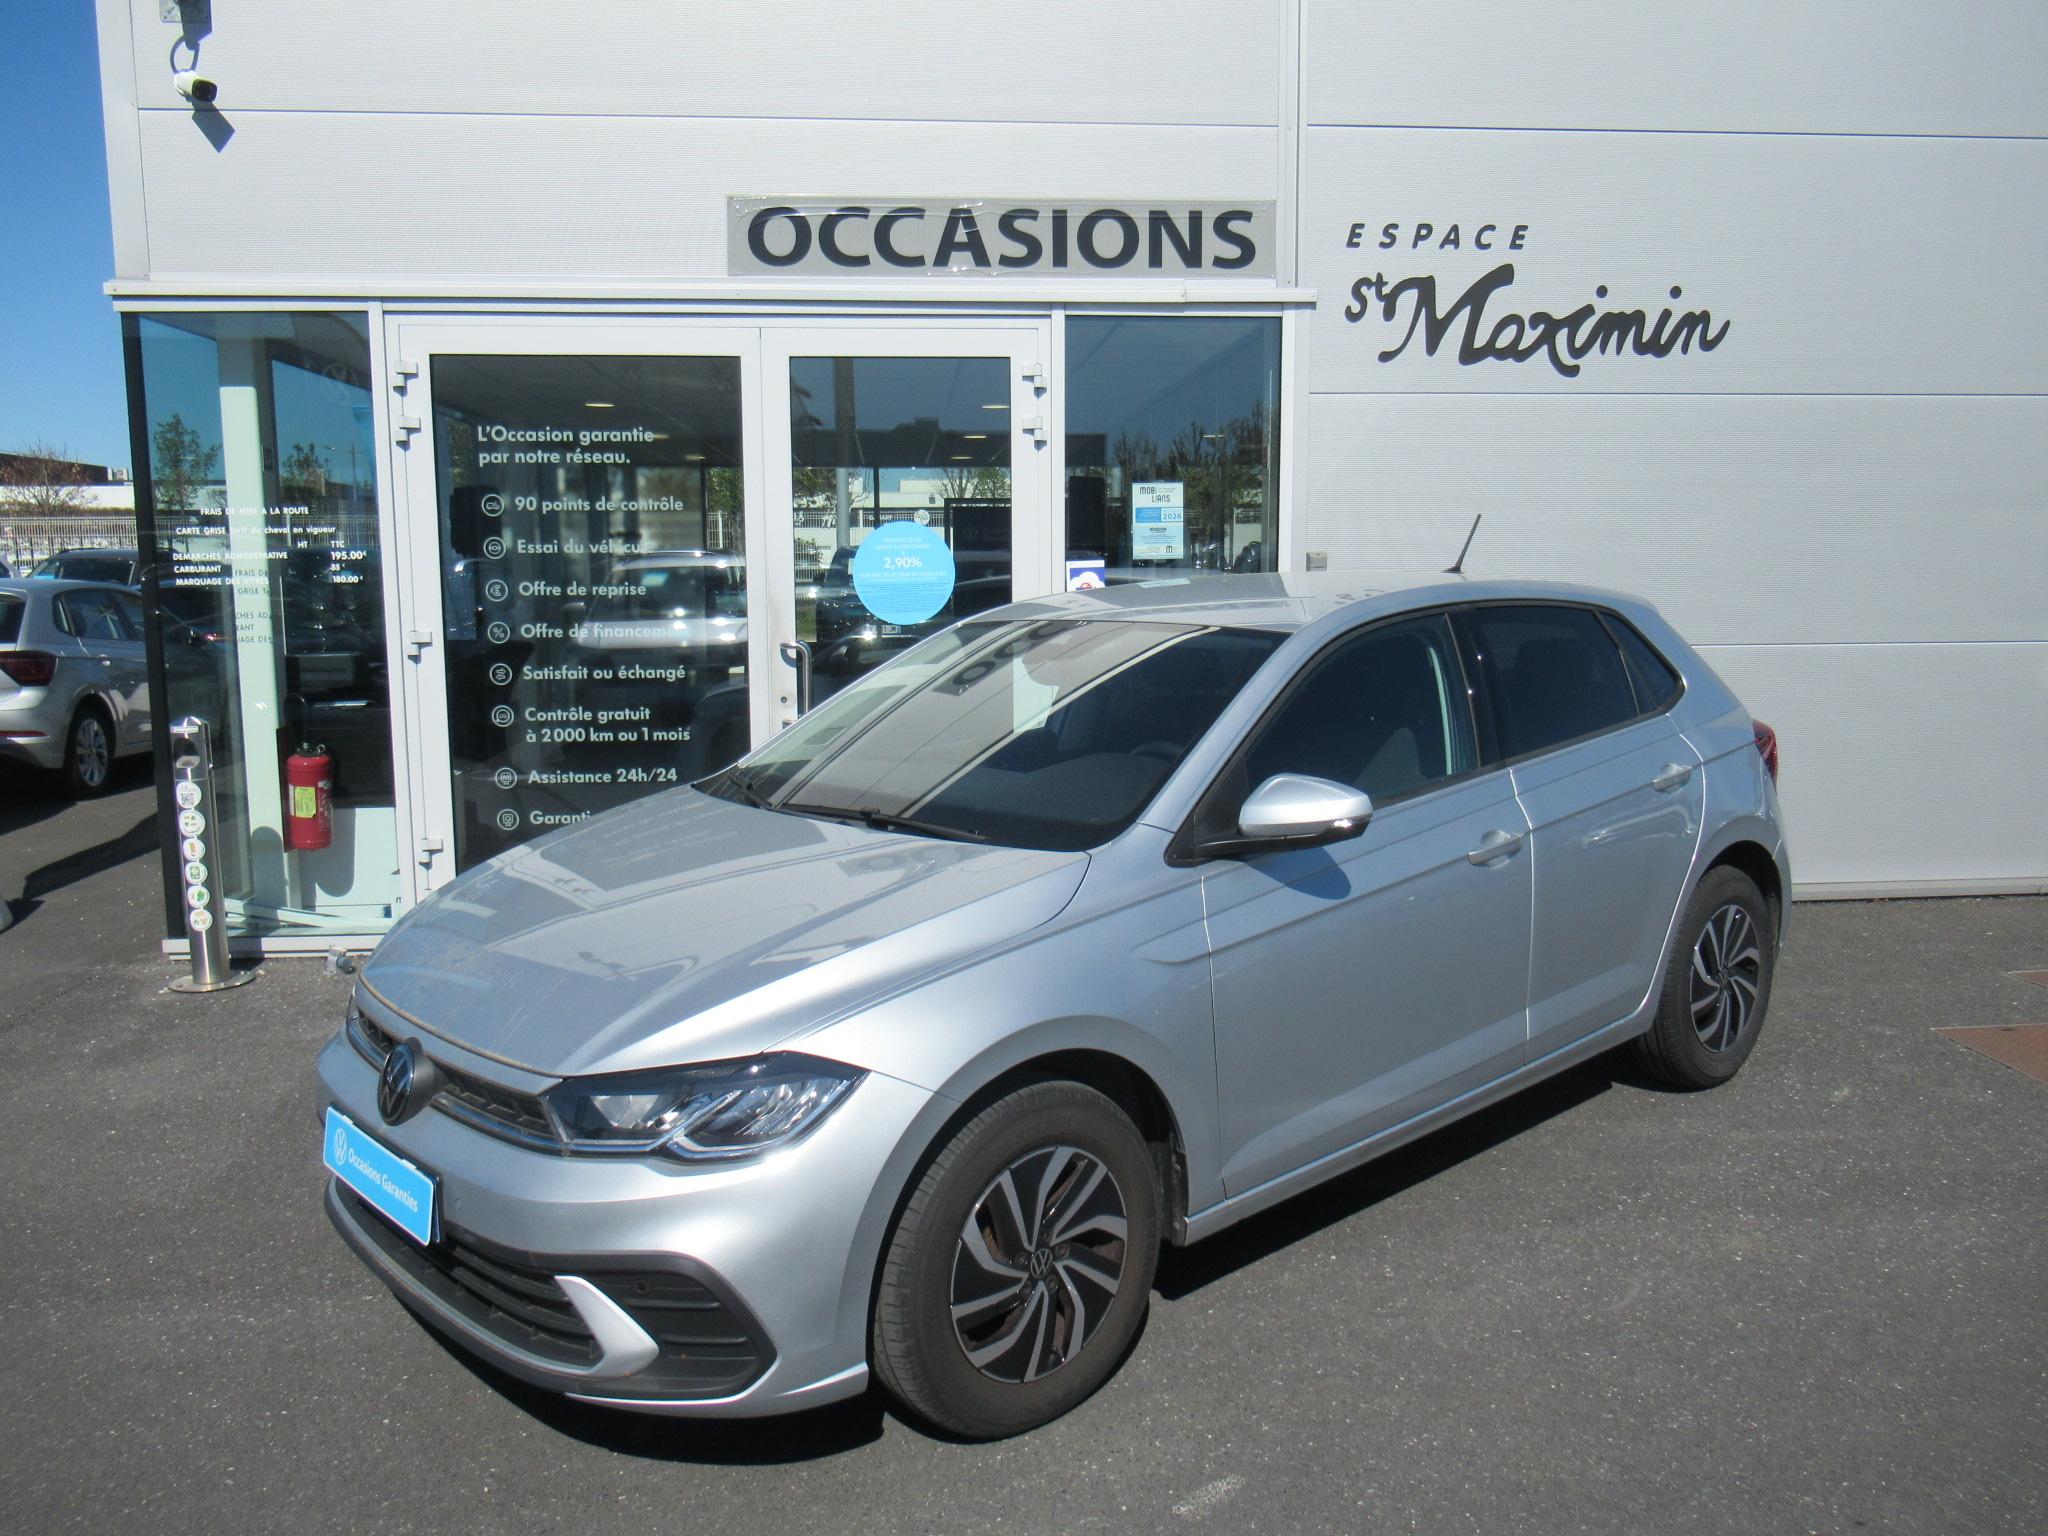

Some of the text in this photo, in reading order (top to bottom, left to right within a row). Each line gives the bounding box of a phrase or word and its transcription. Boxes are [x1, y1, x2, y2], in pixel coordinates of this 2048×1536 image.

[747, 207, 1257, 269] OCCASIONS
[1346, 223, 1529, 250] ESPACE
[1377, 263, 1731, 378] Maximin
[478, 426, 654, 445] L'Occasion garantie
[479, 448, 630, 467] par notre réseau.
[270, 507, 281, 515] LA
[283, 506, 309, 515] ROUTE
[515, 495, 683, 514] 90 points de contrôle
[1162, 512, 1182, 521] 2026
[204, 527, 226, 535] GRISE
[306, 526, 336, 535] vigueur
[331, 540, 345, 548] TTC
[517, 540, 558, 554] Essai
[564, 539, 584, 554] du
[172, 552, 221, 560] DEMARCHES
[883, 556, 922, 570] 2,90%
[174, 565, 222, 573] CARBURANT
[175, 577, 222, 586] MARQUAGE
[519, 581, 646, 599] Offre de reprise
[521, 623, 691, 637] Offre de financem
[523, 664, 685, 682] Satisfait ou échangé
[525, 706, 650, 723] Contrôle gratuit
[527, 729, 537, 742] à
[590, 728, 614, 742] km
[619, 730, 637, 742] ou
[642, 727, 648, 741] 1
[653, 727, 691, 741] mois
[528, 768, 678, 783] Assistance 24h/24
[348, 1149, 381, 1184] Occasions
[382, 1173, 418, 1213] Garanties
